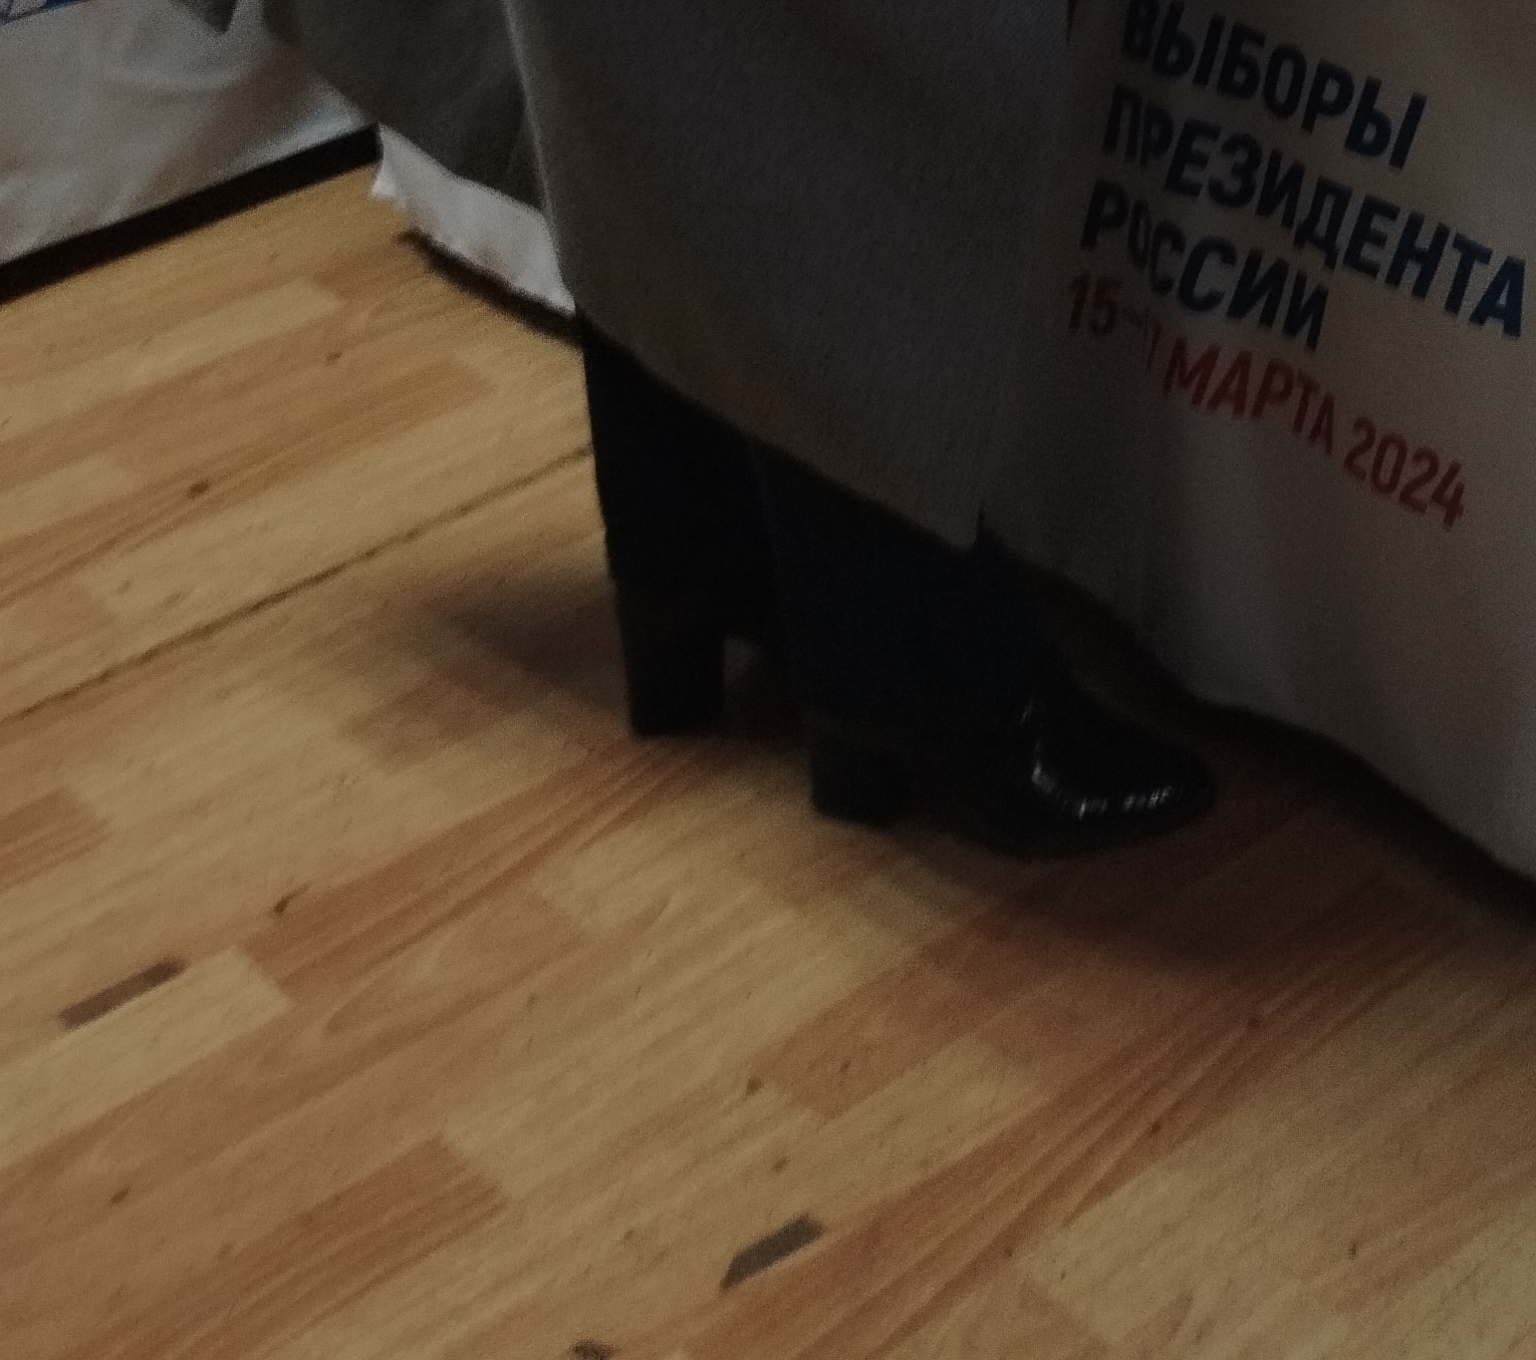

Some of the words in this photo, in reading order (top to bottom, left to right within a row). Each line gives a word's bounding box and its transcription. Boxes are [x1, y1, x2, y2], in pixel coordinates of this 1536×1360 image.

[1079, 179, 1330, 353] РОССИИ
[1101, 84, 1528, 340] ПРЕЗИДЕНТА
[1161, 337, 1336, 456] МАРТА
[1342, 415, 1466, 530] 2024
